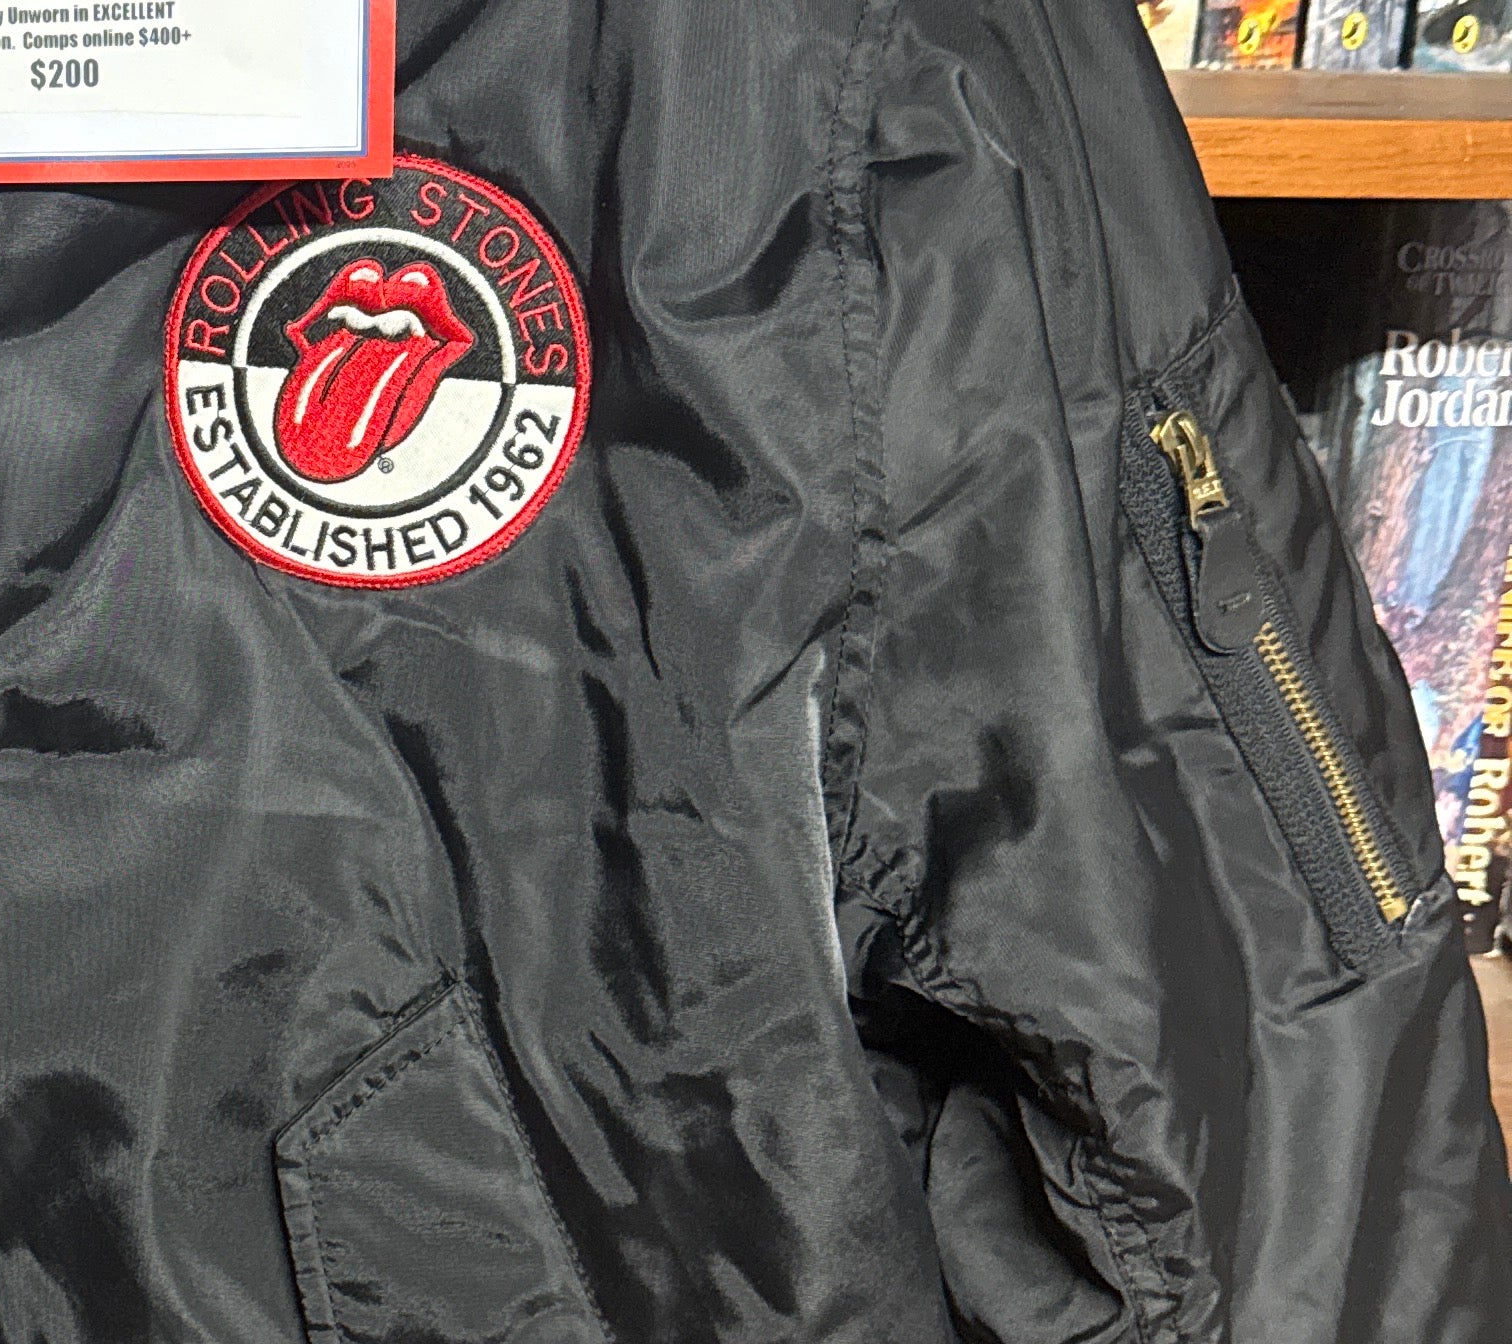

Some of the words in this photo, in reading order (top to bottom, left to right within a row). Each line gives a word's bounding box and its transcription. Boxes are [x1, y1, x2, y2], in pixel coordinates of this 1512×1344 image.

[7, 5, 70, 25] Unworn
[73, 4, 89, 23] in
[92, 1, 176, 22] EXCELLENT
[22, 30, 79, 51] Comps
[82, 28, 135, 48] online
[138, 26, 192, 47] $400+
[30, 57, 100, 91] $200
[186, 175, 376, 358] ROLLING
[410, 180, 570, 378] STONES
[185, 384, 471, 572] ESTABLISHED
[467, 406, 563, 522] 1962
